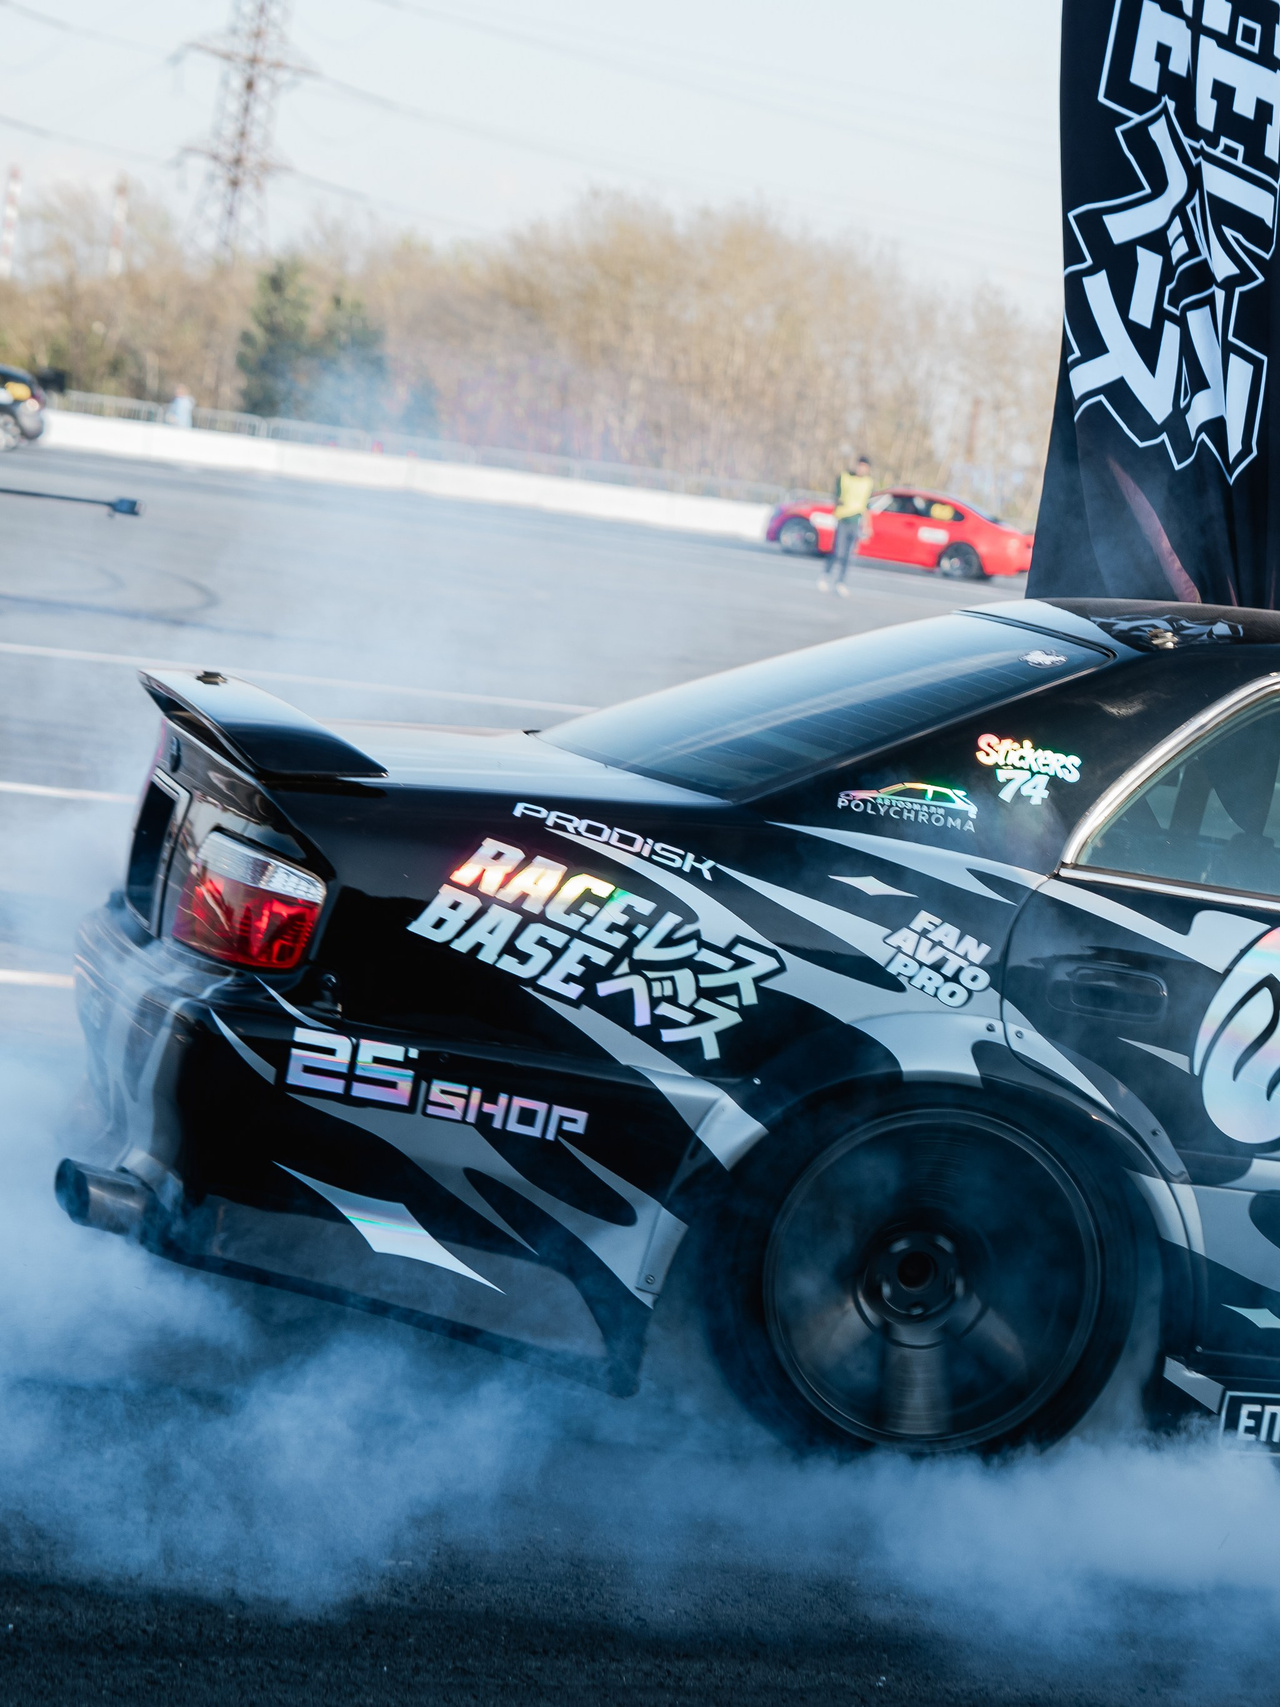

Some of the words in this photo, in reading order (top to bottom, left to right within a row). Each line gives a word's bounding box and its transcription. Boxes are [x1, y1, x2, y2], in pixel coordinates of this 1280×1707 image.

[837, 798, 976, 833] POLYCHROMA
[996, 769, 1050, 805] 74
[450, 837, 657, 948] RAGE
[406, 884, 614, 1000] BASE
[884, 927, 990, 991] AVTO
[909, 910, 991, 964] FAN
[886, 953, 968, 1007] PRO
[425, 1080, 588, 1141] SHOP
